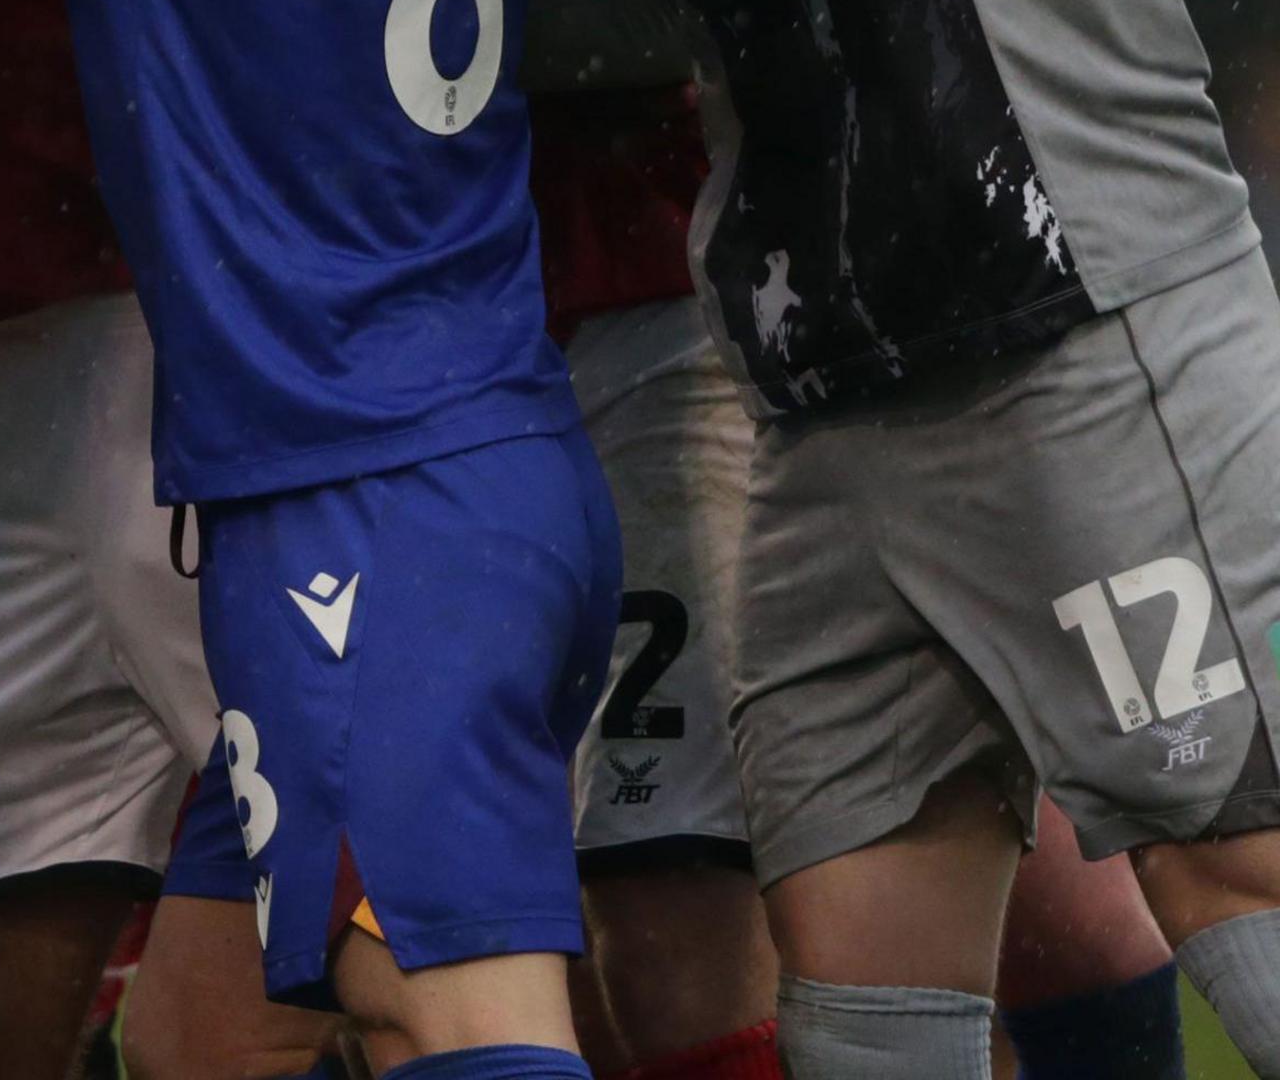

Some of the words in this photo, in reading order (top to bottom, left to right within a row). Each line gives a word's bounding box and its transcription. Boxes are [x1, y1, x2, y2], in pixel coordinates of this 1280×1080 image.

[1052, 557, 1246, 734] 12
[1161, 736, 1212, 771] FBT
[609, 784, 661, 805] FBT
